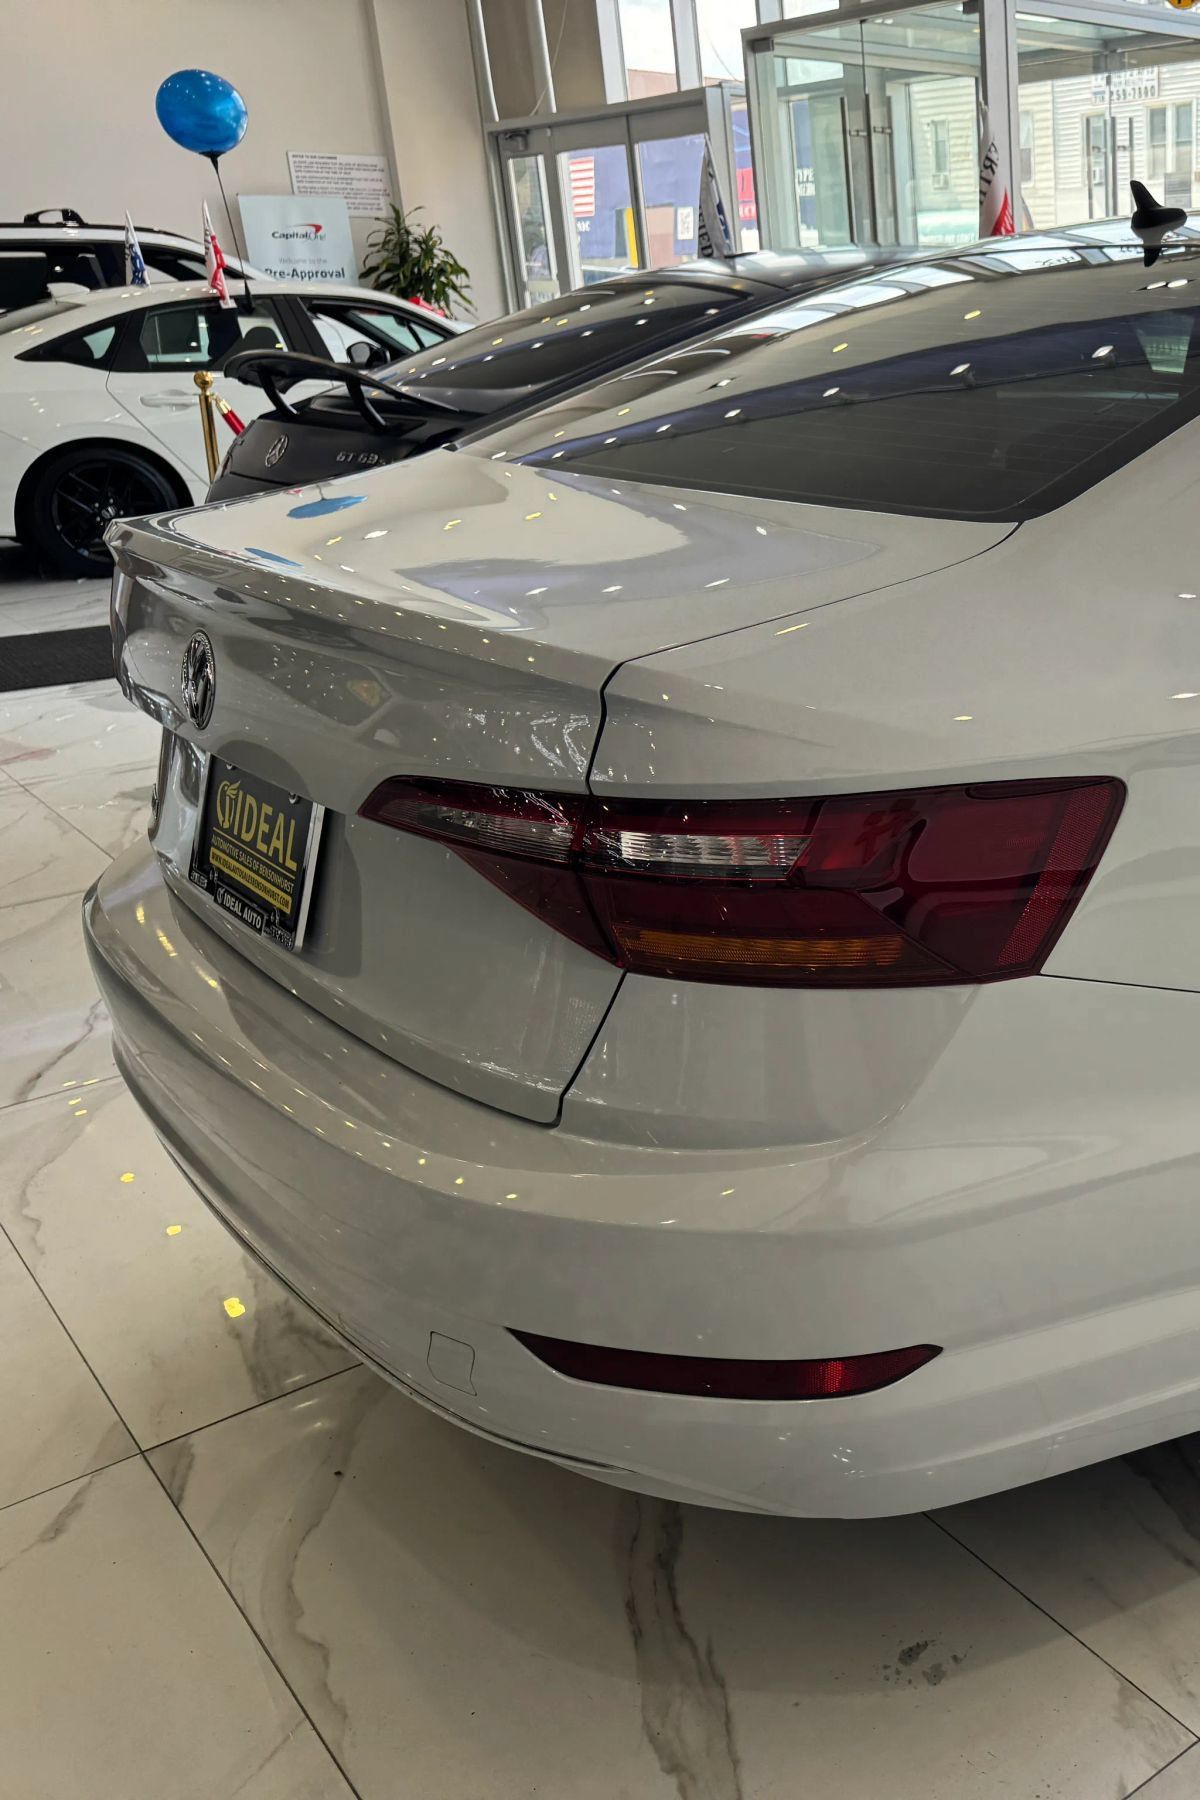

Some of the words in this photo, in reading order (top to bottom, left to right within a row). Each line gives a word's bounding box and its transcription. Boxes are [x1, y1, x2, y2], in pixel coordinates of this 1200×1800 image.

[233, 789, 298, 872] IDEAL
[211, 834, 240, 860] AUTOMOTIVE
[239, 851, 253, 868] SALES
[259, 863, 295, 894] BENSONHURST
[223, 892, 242, 917] IDEAL
[242, 906, 262, 929] AUTO
